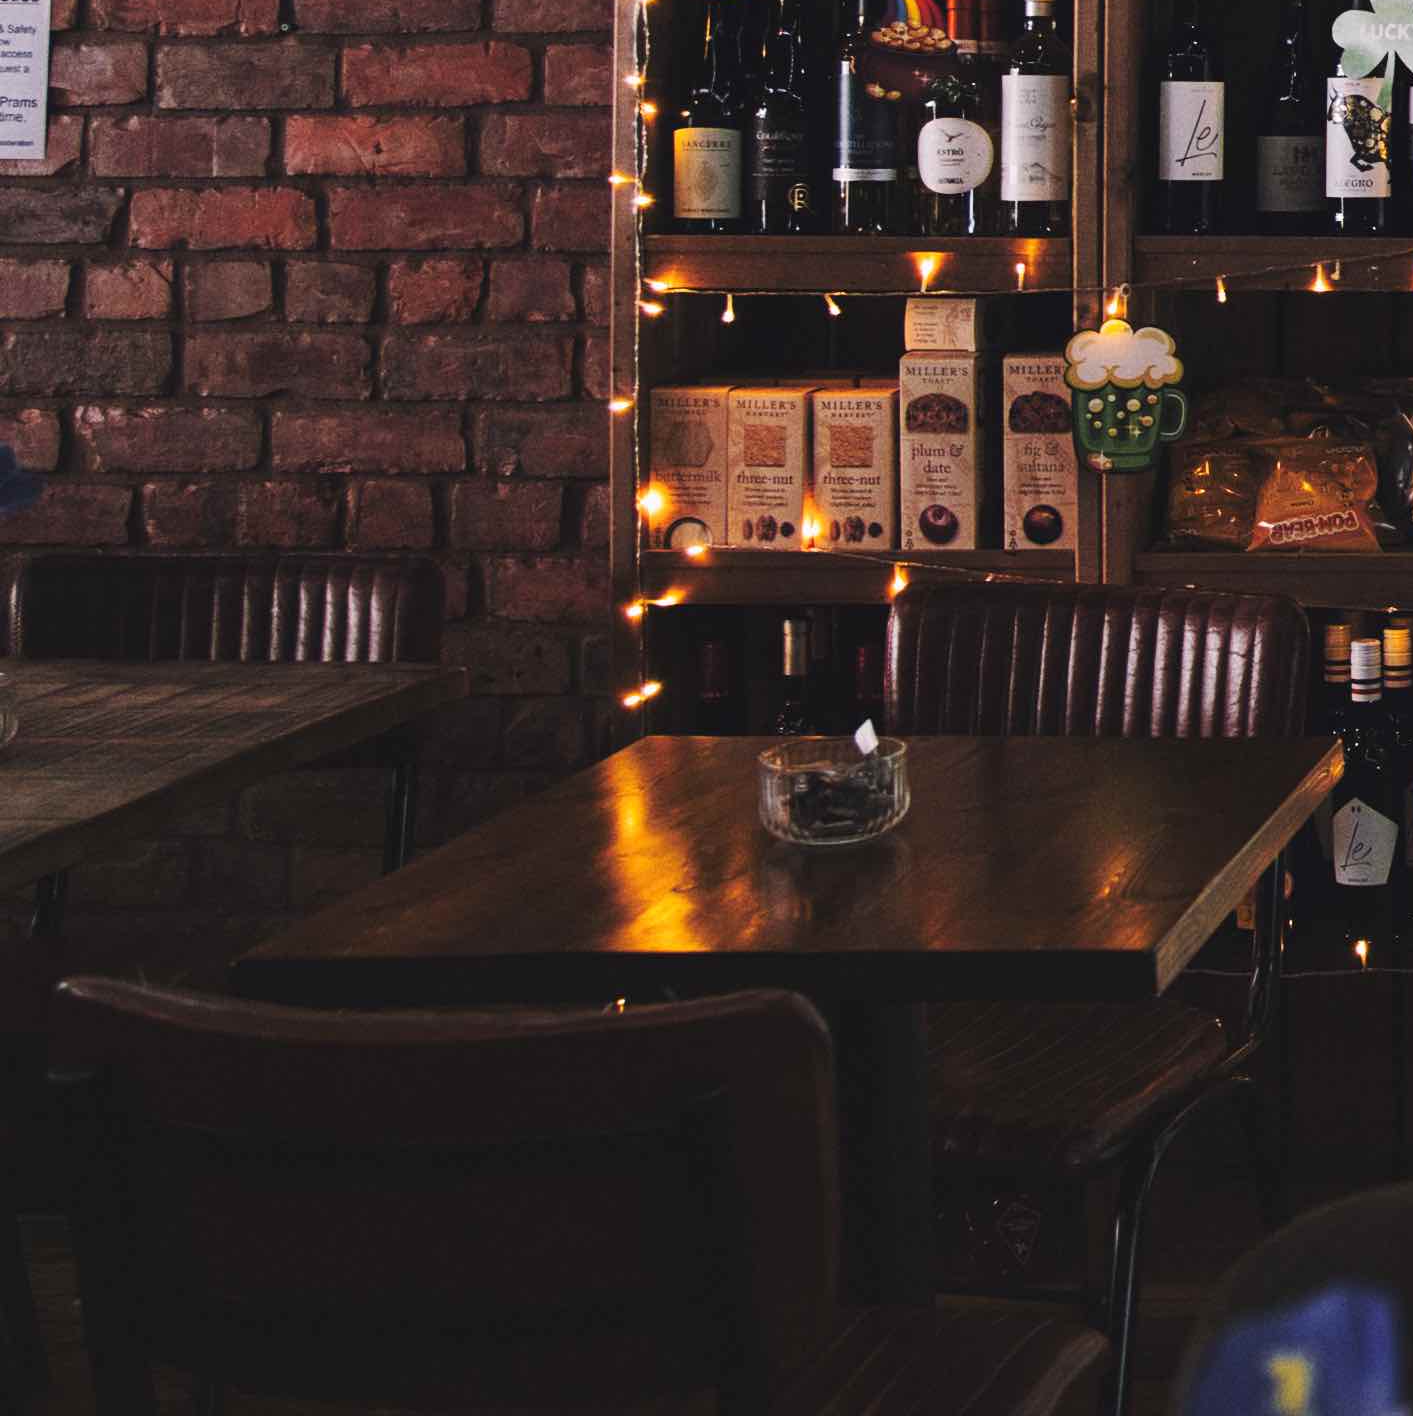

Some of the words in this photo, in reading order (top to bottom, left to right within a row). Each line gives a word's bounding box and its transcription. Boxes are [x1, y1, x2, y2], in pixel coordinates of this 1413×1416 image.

[0, 95, 38, 108] Prams
[1176, 99, 1219, 166] Le
[904, 365, 969, 377] MILLER'S
[1009, 364, 1063, 377] MILLER
[736, 400, 797, 411] MILLER'S
[821, 400, 883, 411] MILLER'S
[911, 442, 947, 461] plum
[924, 461, 953, 475] date
[736, 471, 793, 486] three-nut
[822, 471, 881, 487] three-nut
